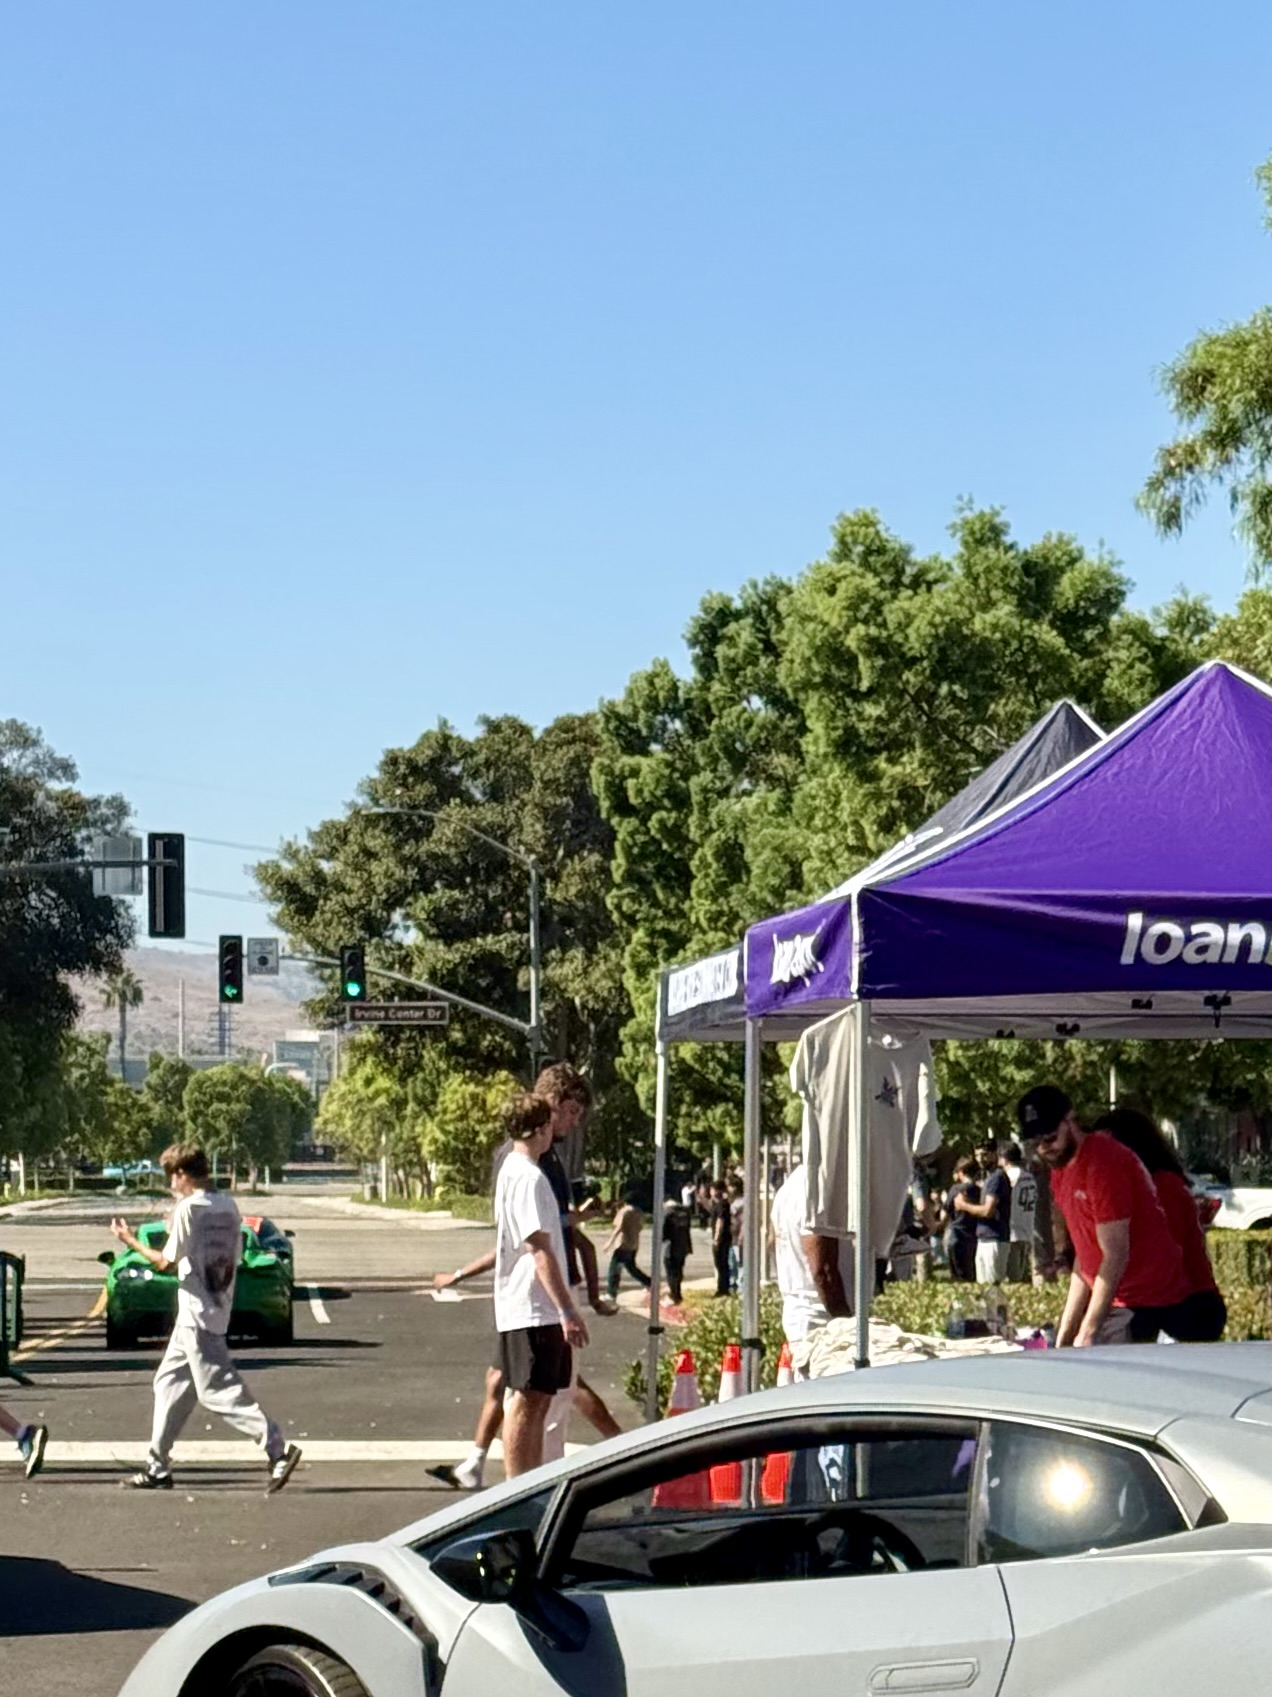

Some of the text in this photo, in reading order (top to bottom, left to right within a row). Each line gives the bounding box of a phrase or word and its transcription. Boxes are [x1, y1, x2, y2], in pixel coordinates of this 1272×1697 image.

[354, 1008, 442, 1018] Irvine Center Dr
